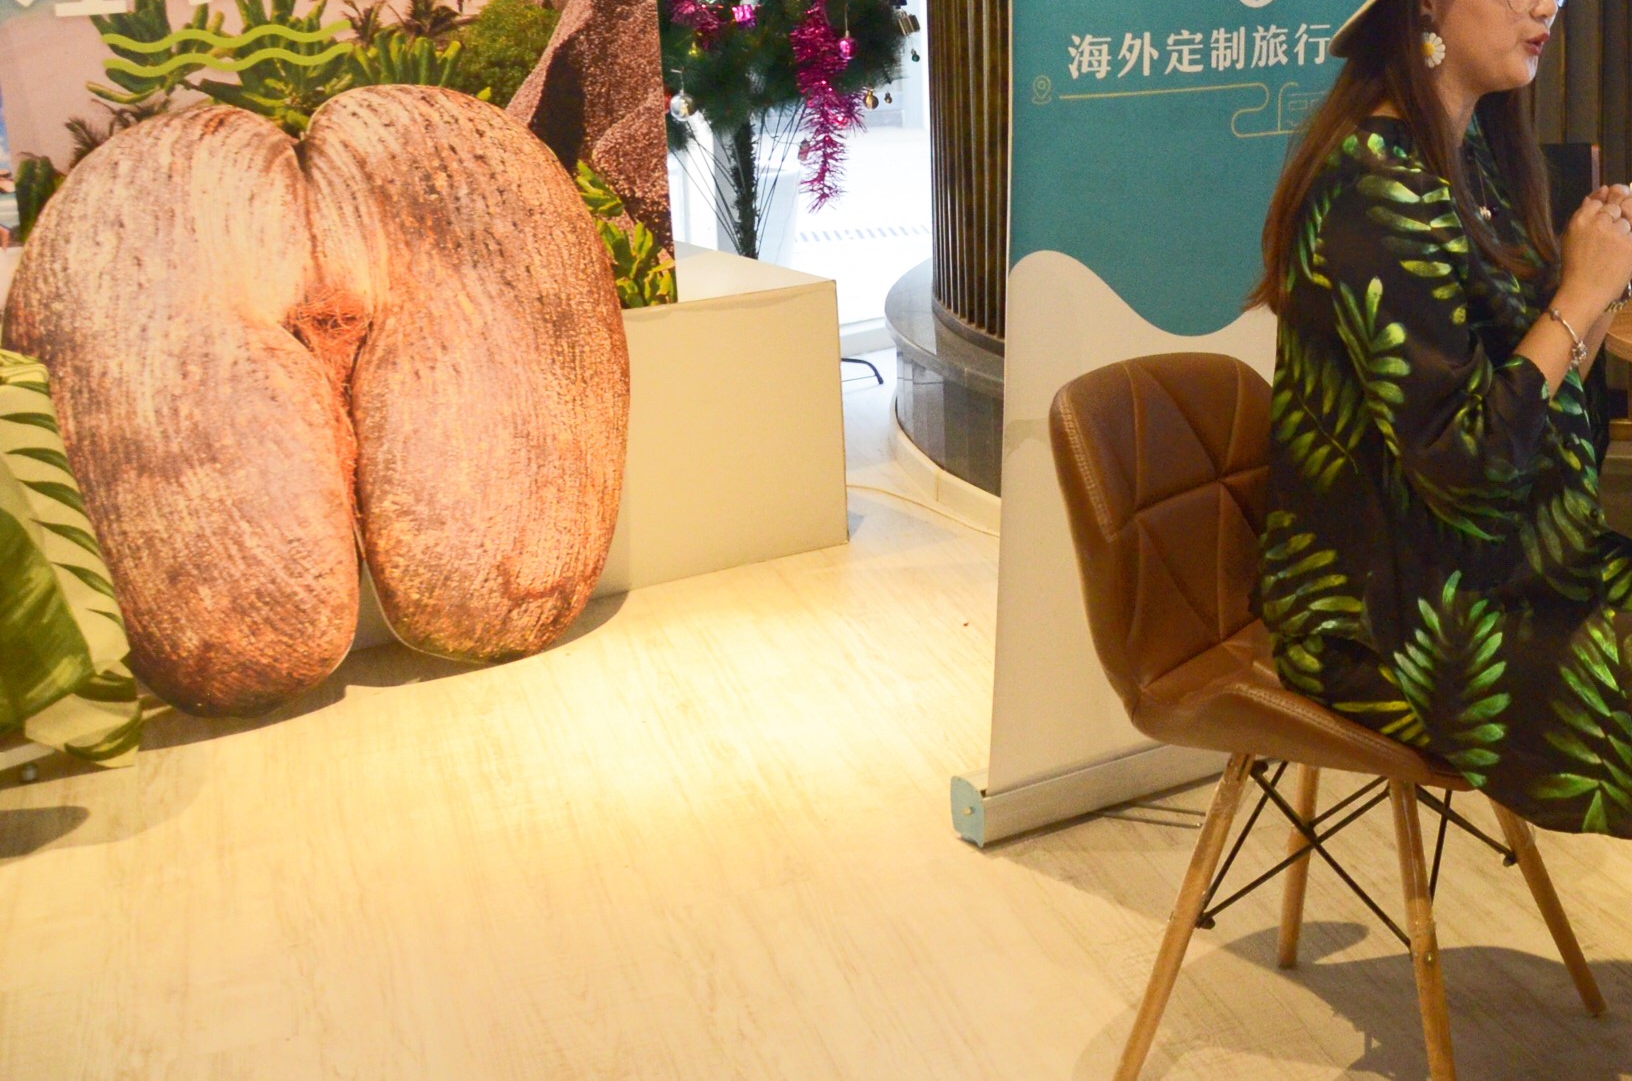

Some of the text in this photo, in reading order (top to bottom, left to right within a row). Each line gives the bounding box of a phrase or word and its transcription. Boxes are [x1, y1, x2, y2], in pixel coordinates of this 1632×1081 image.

[1067, 22, 1332, 80] 海外定制旅行
